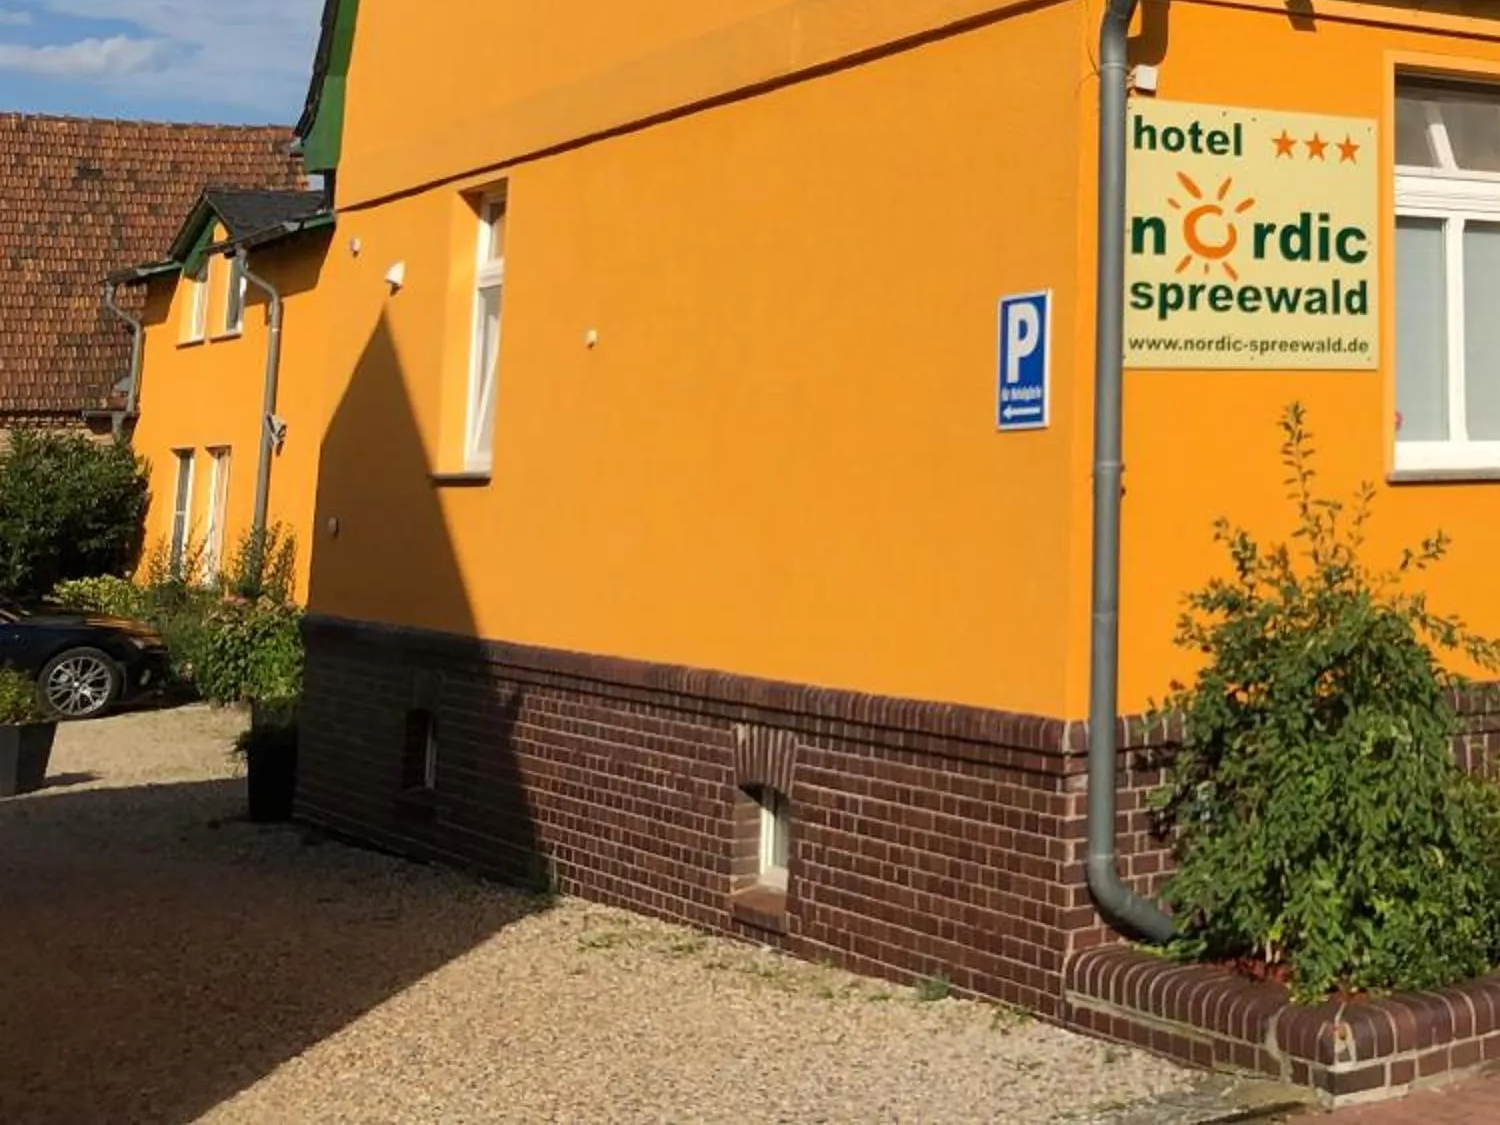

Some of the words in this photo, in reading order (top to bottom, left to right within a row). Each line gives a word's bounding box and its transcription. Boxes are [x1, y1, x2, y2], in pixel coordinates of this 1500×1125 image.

[1133, 115, 1243, 156] hotel
[1130, 204, 1368, 264] nordic
[1129, 279, 1369, 320] spreewald
[1007, 302, 1039, 383] P
[1128, 335, 1369, 354] www.nordic-spreewald.de
